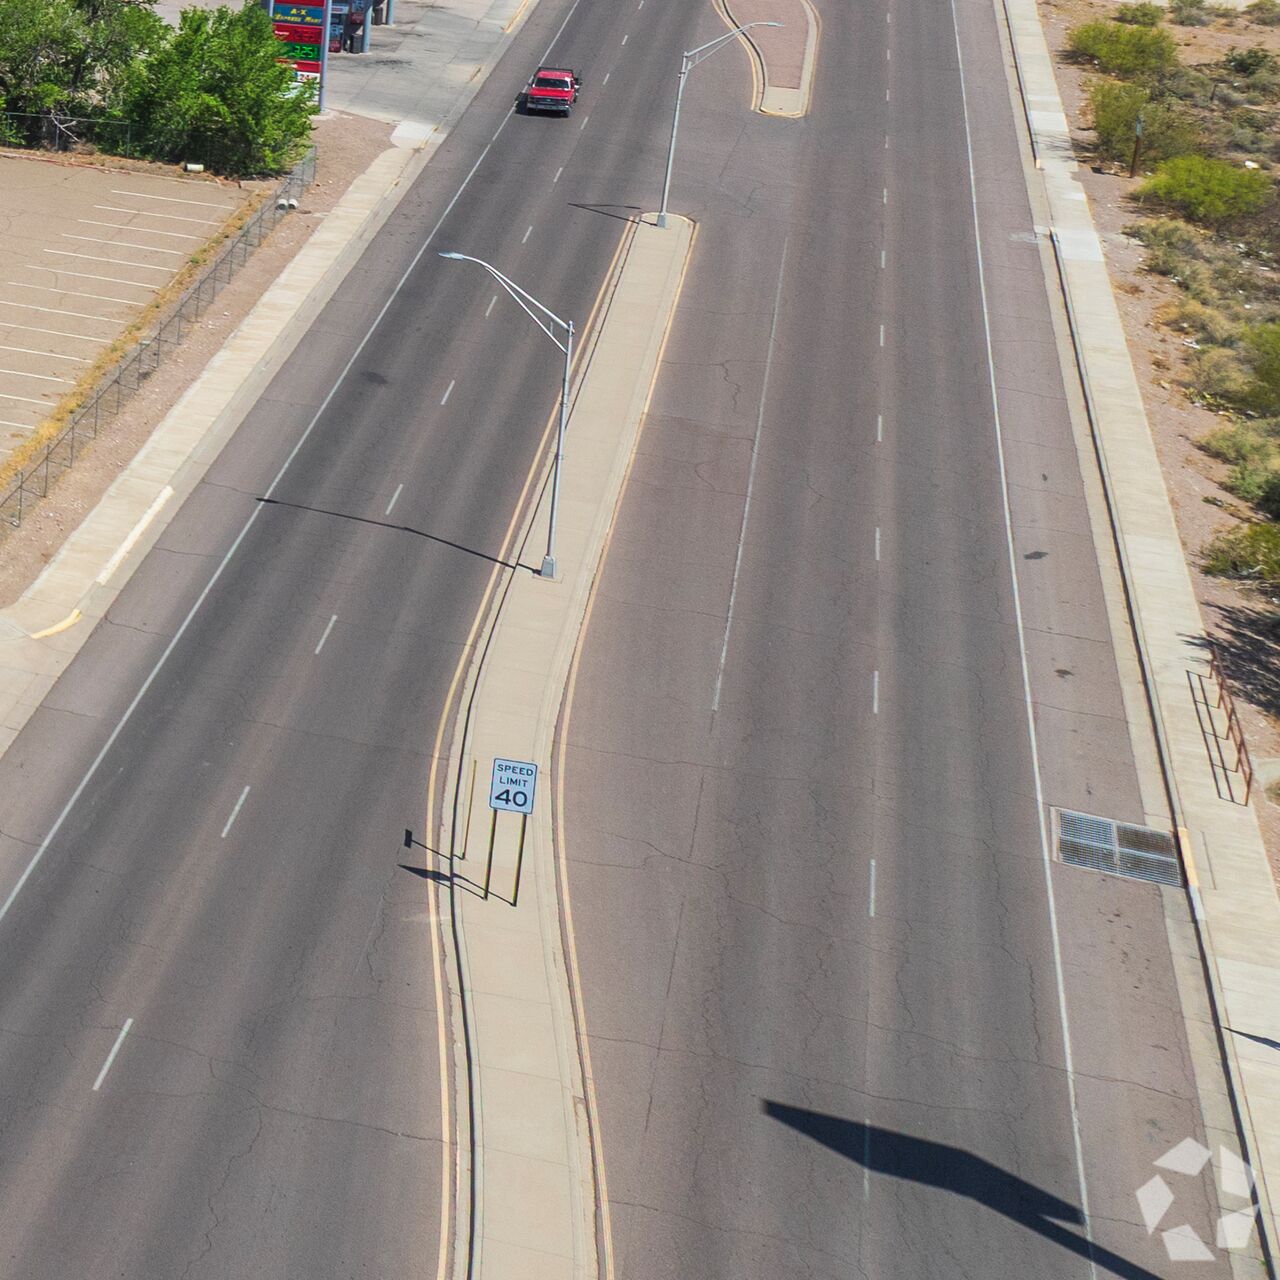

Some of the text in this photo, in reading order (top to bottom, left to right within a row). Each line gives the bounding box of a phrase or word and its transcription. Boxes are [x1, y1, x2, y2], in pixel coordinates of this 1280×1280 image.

[496, 764, 534, 776] SPEED
[499, 776, 529, 787] LIMIT
[494, 788, 528, 807] 40
